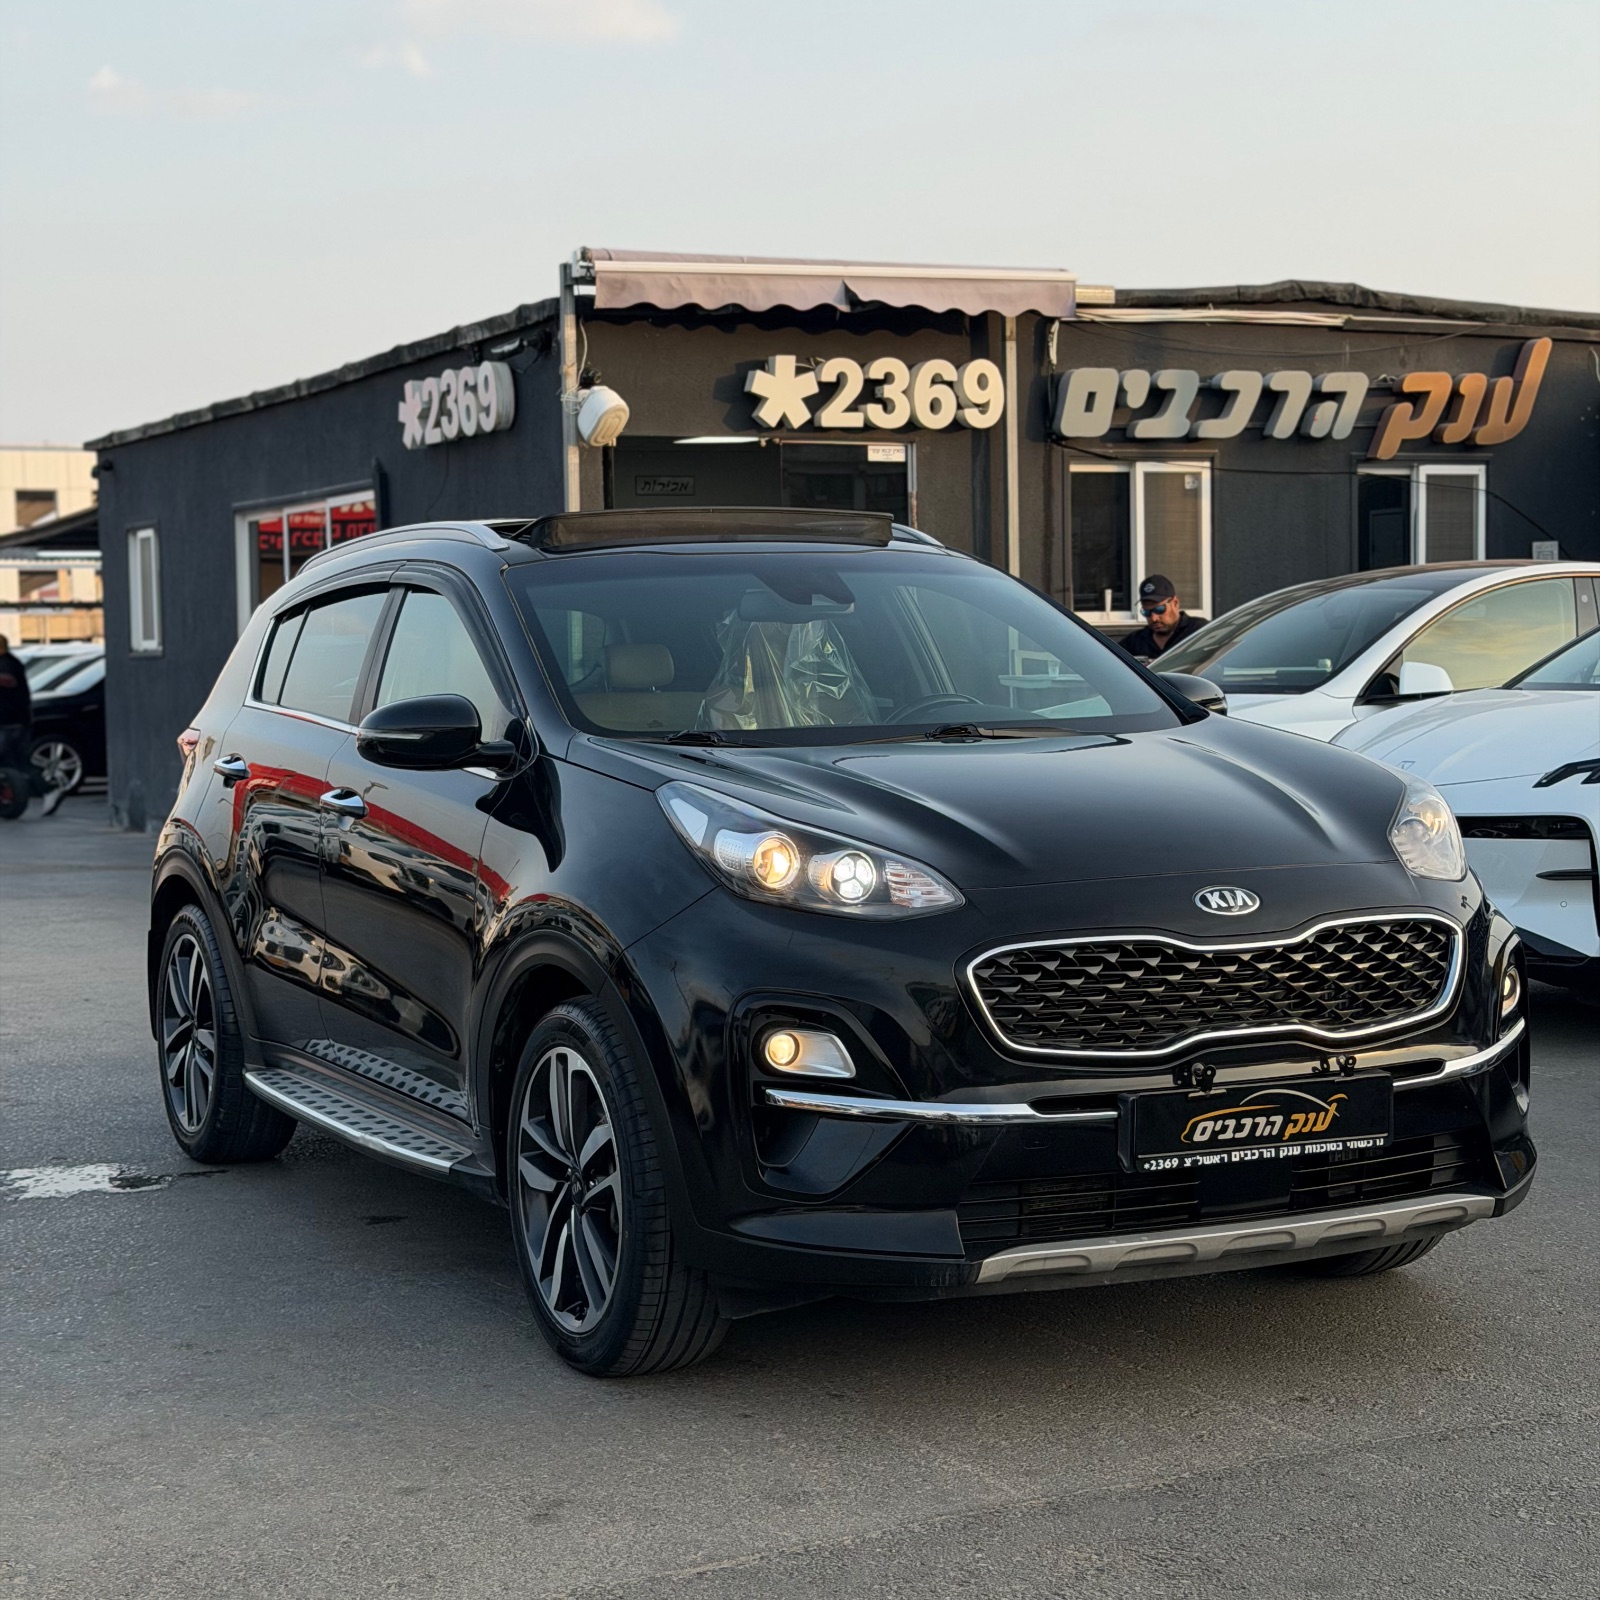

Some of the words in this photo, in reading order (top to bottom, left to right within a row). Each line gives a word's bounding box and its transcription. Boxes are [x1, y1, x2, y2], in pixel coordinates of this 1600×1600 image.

[1058, 367, 1370, 440] הרכבים
[1368, 337, 1552, 460] ענק
[640, 480, 690, 492] מכירות
[1204, 890, 1254, 909] KIA
[1192, 1115, 1284, 1142] הרכבים
[1282, 1102, 1338, 1141] ענק
[1231, 1148, 1275, 1162] הרכבים
[1279, 1145, 1301, 1158] ענק
[1304, 1141, 1343, 1154] בסוכנות
